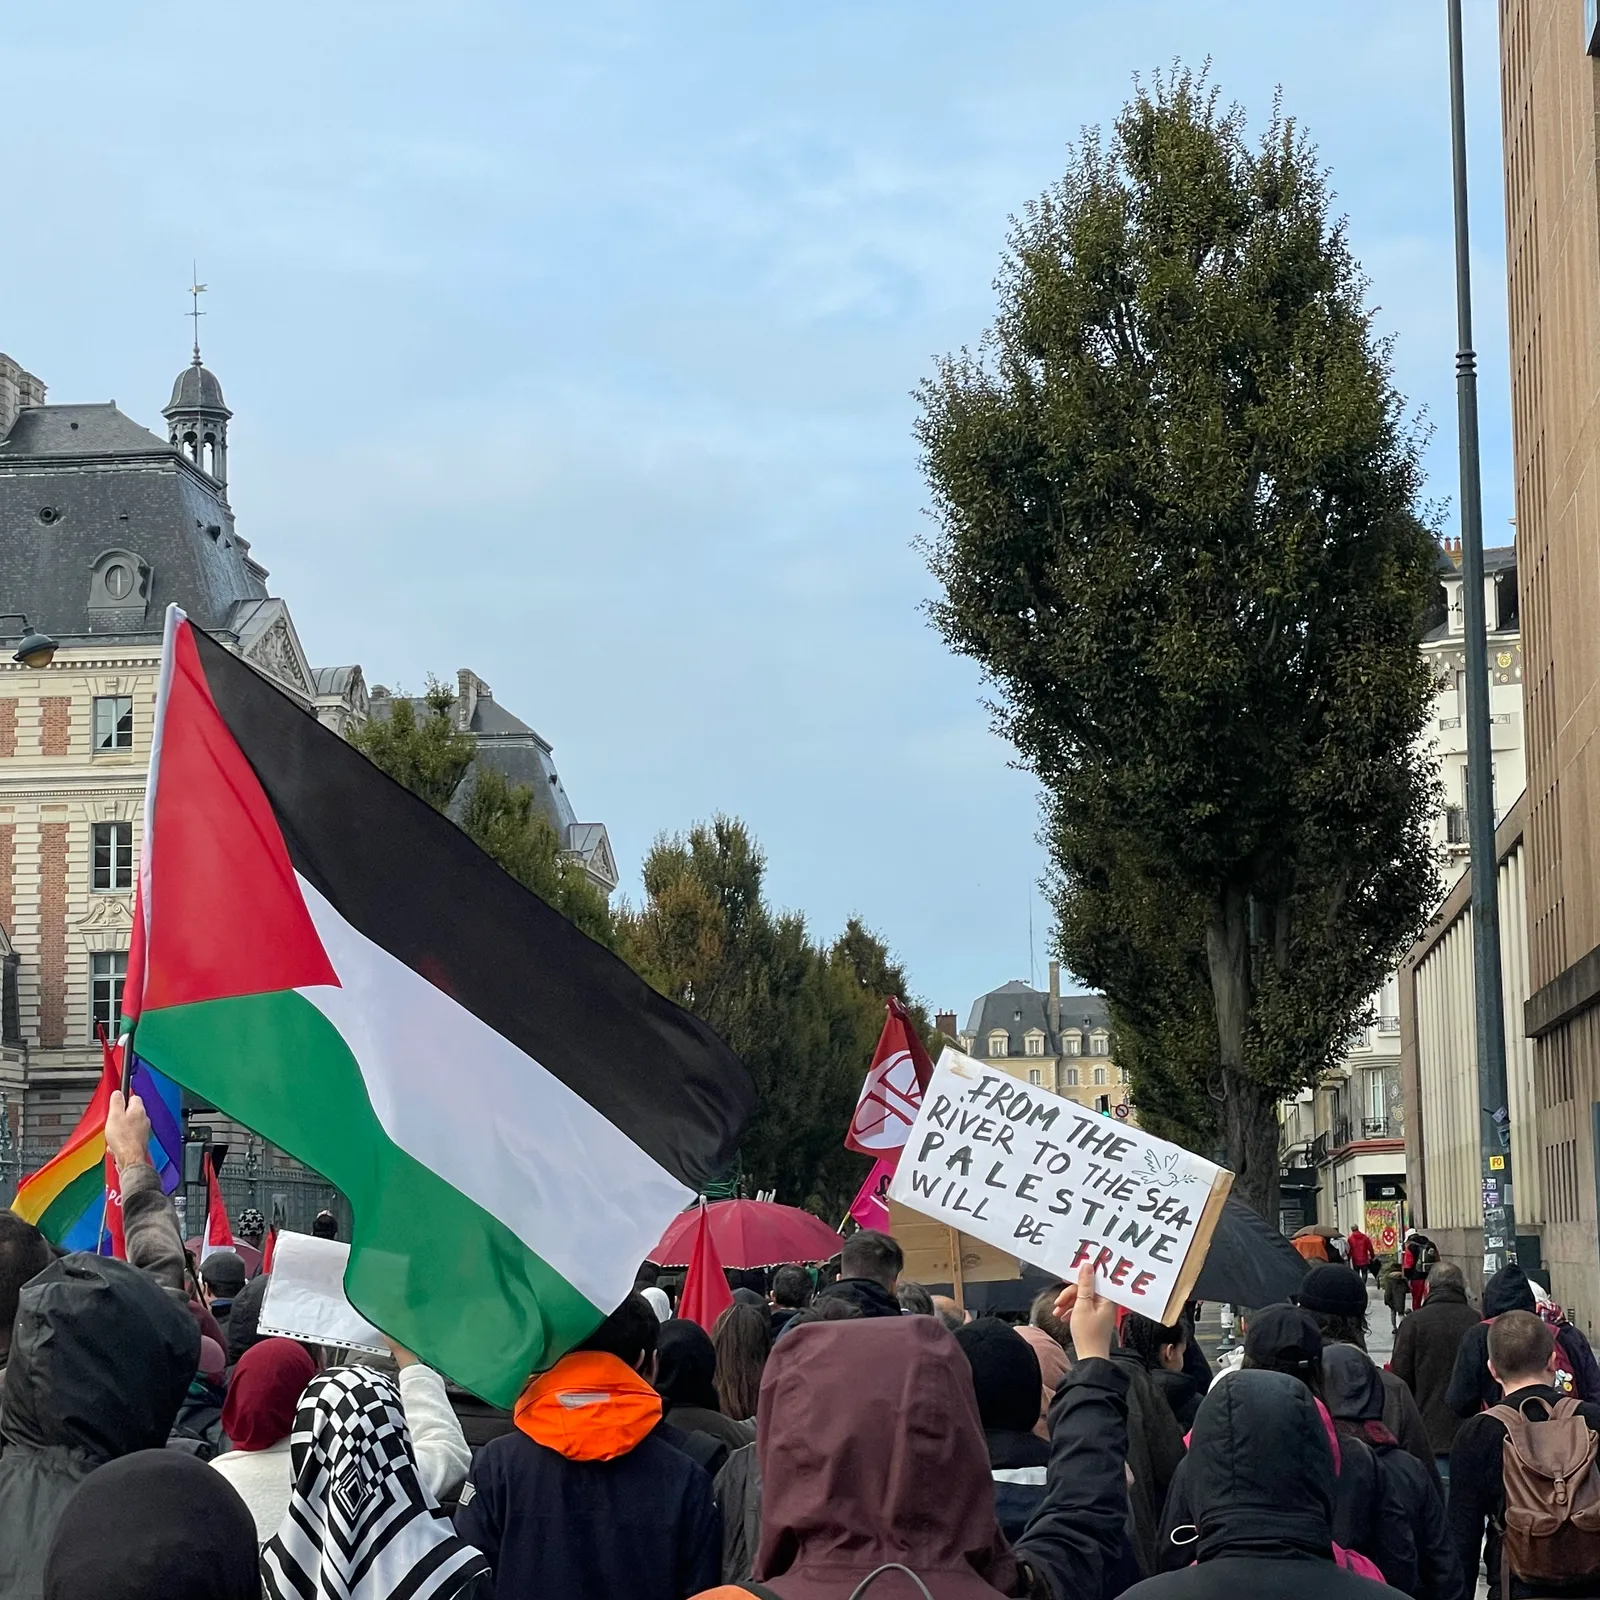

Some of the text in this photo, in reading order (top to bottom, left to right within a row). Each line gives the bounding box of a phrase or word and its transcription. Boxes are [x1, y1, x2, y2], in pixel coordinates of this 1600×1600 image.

[926, 1094, 1193, 1231] RIVER TO THE SEA
[967, 1076, 1061, 1132] FROM
[1066, 1115, 1138, 1162] THE
[912, 1170, 1157, 1296] WILL BE FREE
[917, 1131, 1178, 1264] PALESTINE
